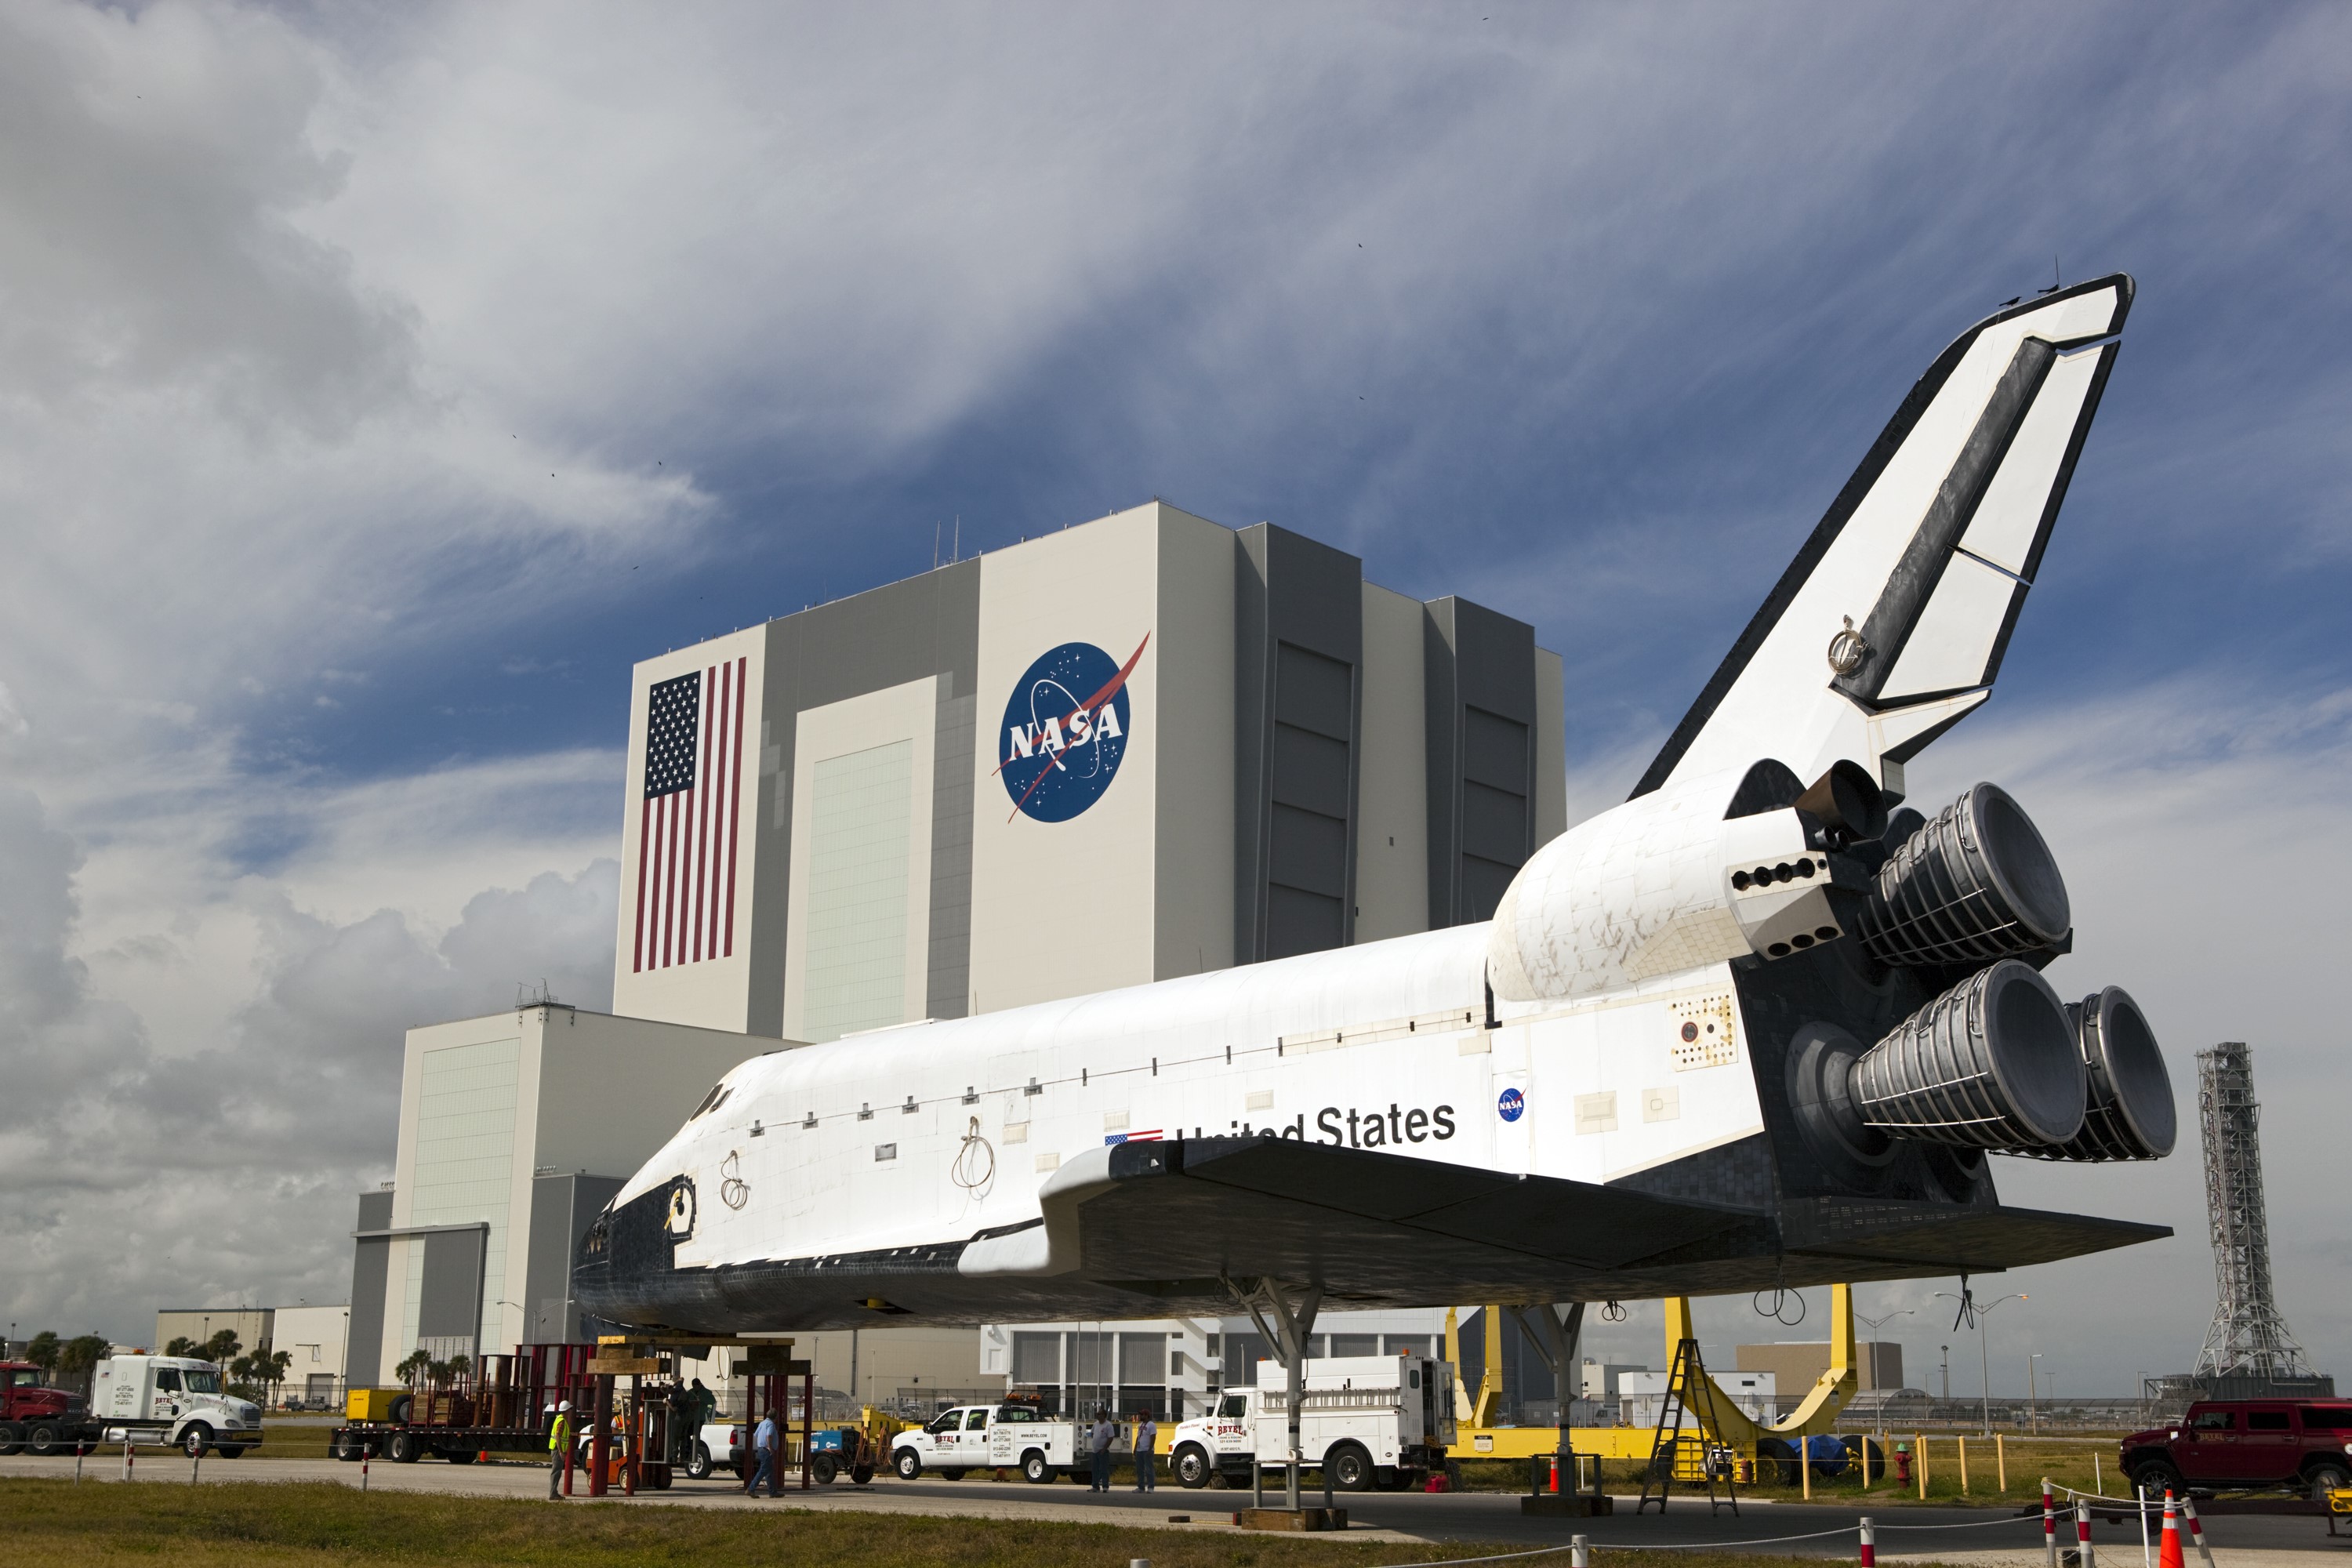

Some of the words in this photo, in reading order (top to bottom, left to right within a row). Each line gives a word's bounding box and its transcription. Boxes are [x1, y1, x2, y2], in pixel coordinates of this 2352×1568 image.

[1009, 703, 1123, 761] NASA
[1500, 1101, 1523, 1110] NASA
[1317, 1103, 1456, 1149] States
[1218, 1425, 1243, 1436] BEYEL
[935, 1436, 954, 1444] BEYEL
[2200, 1432, 2225, 1441] BEYEL
